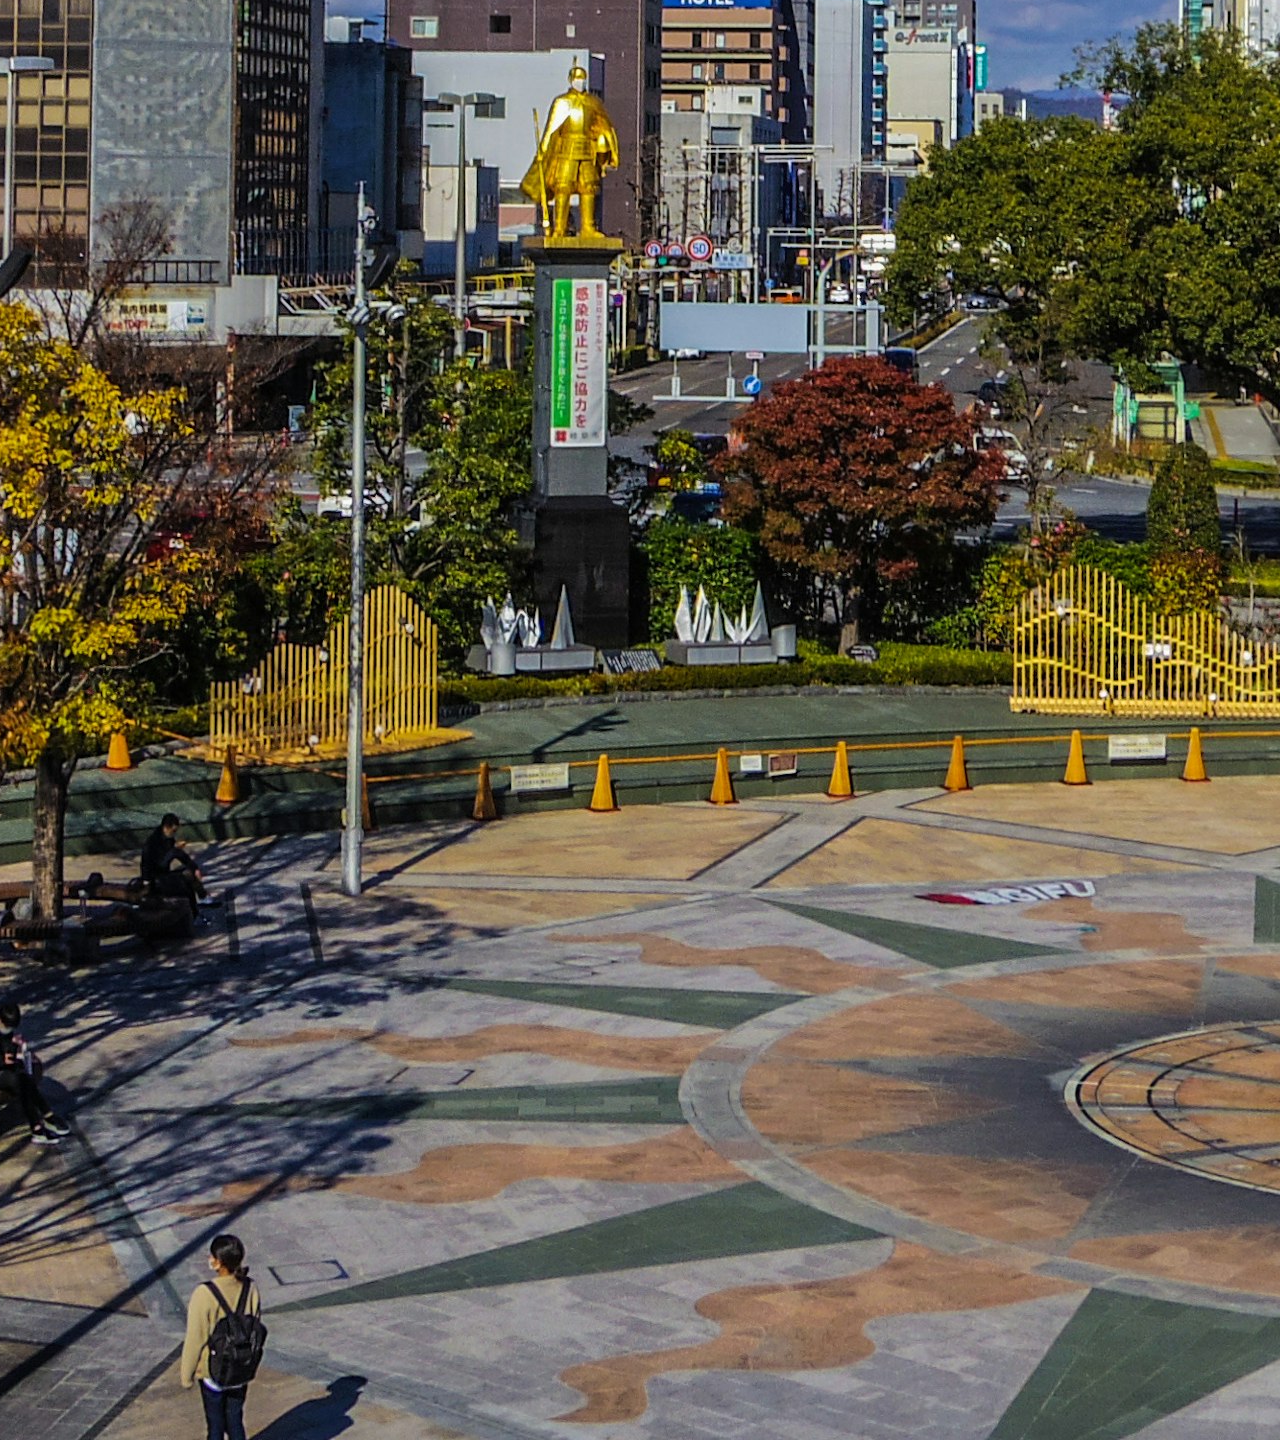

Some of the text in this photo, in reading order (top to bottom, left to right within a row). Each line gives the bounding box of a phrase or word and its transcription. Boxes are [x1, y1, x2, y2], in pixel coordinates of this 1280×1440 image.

[693, 243, 706, 254] 50
[574, 286, 589, 428] 感染防止にご協力を
